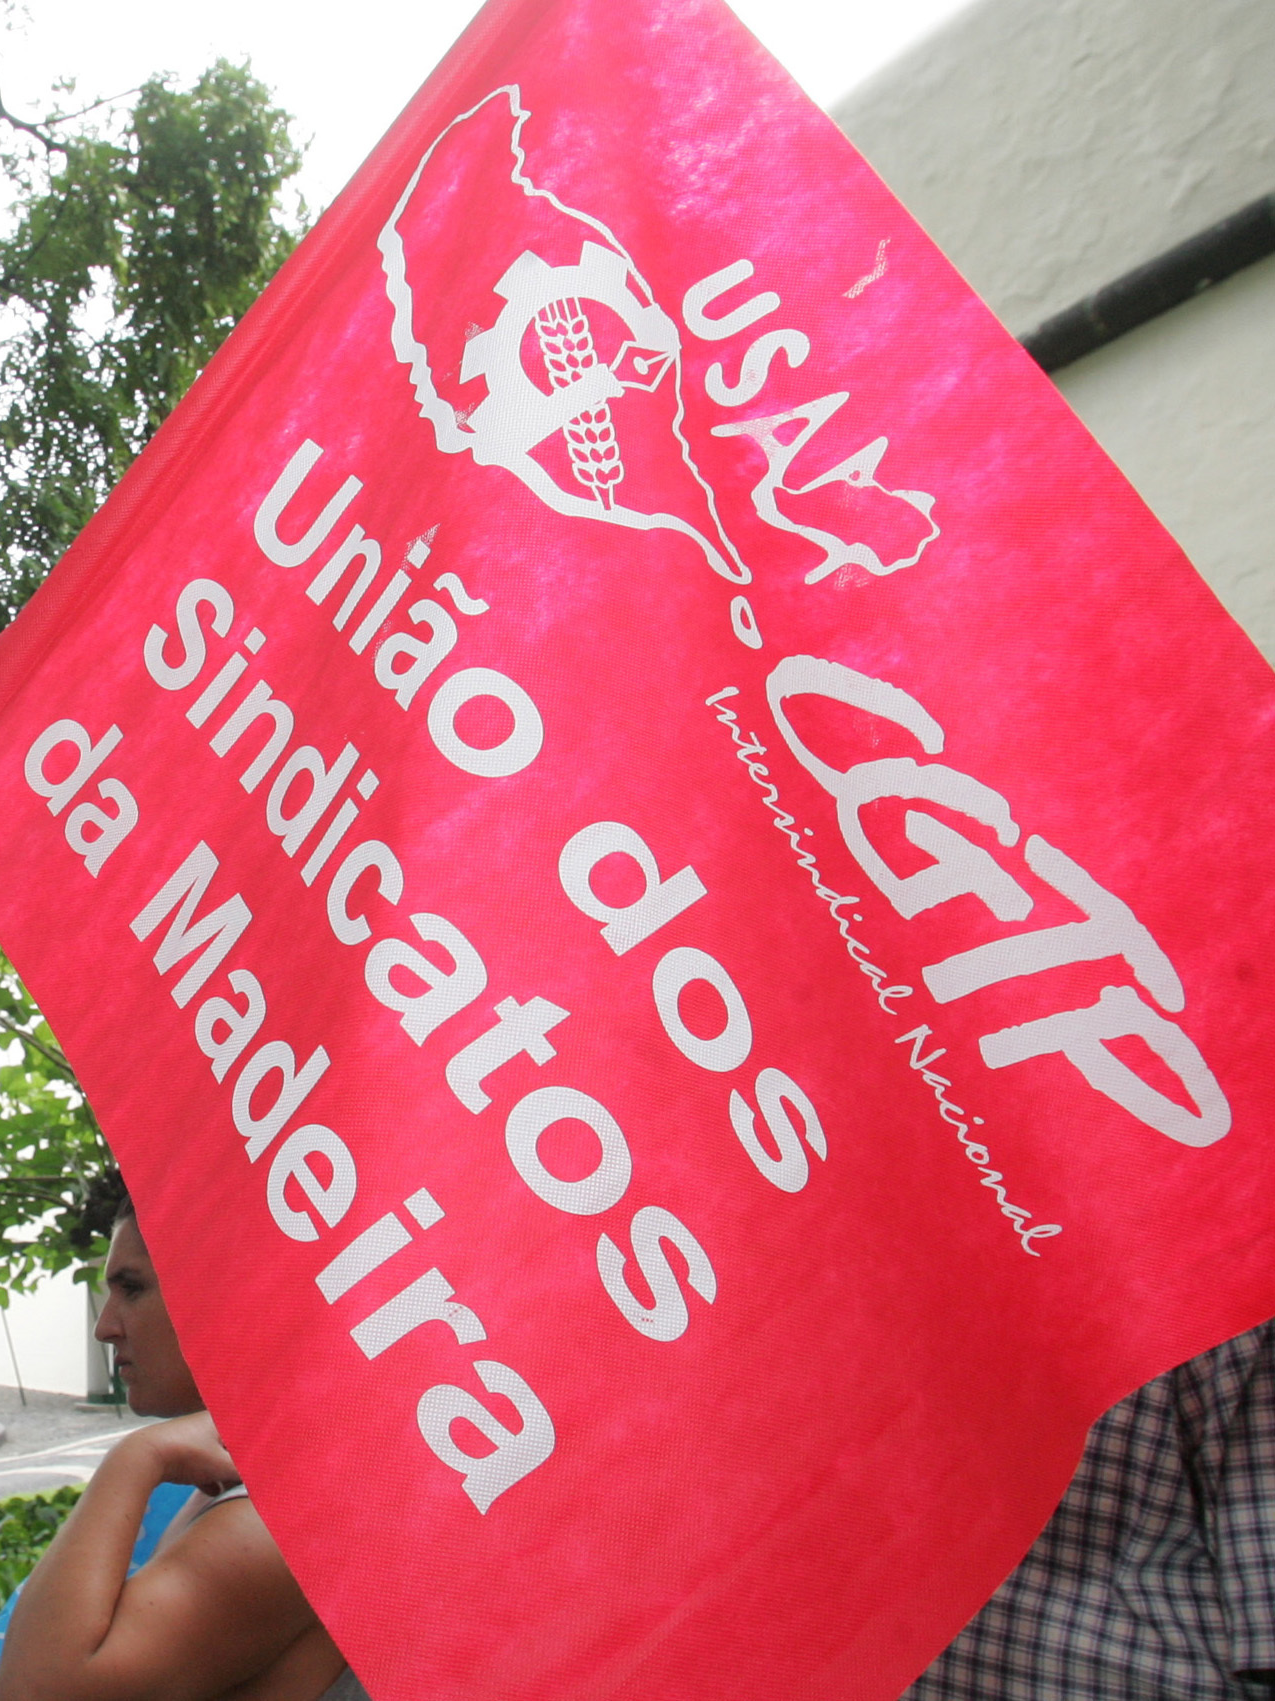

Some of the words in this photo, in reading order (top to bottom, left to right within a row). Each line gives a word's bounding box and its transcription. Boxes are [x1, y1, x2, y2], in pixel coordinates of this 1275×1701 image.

[24, 719, 139, 878] da
[129, 840, 556, 1515] Madeira
[143, 578, 717, 1342] Sindicatos
[254, 438, 544, 778] União
[558, 821, 826, 1193] dos
[705, 686, 914, 1016] Intersindical
[895, 1023, 1063, 1257] Nacional
[766, 654, 1232, 1148] CGTP
